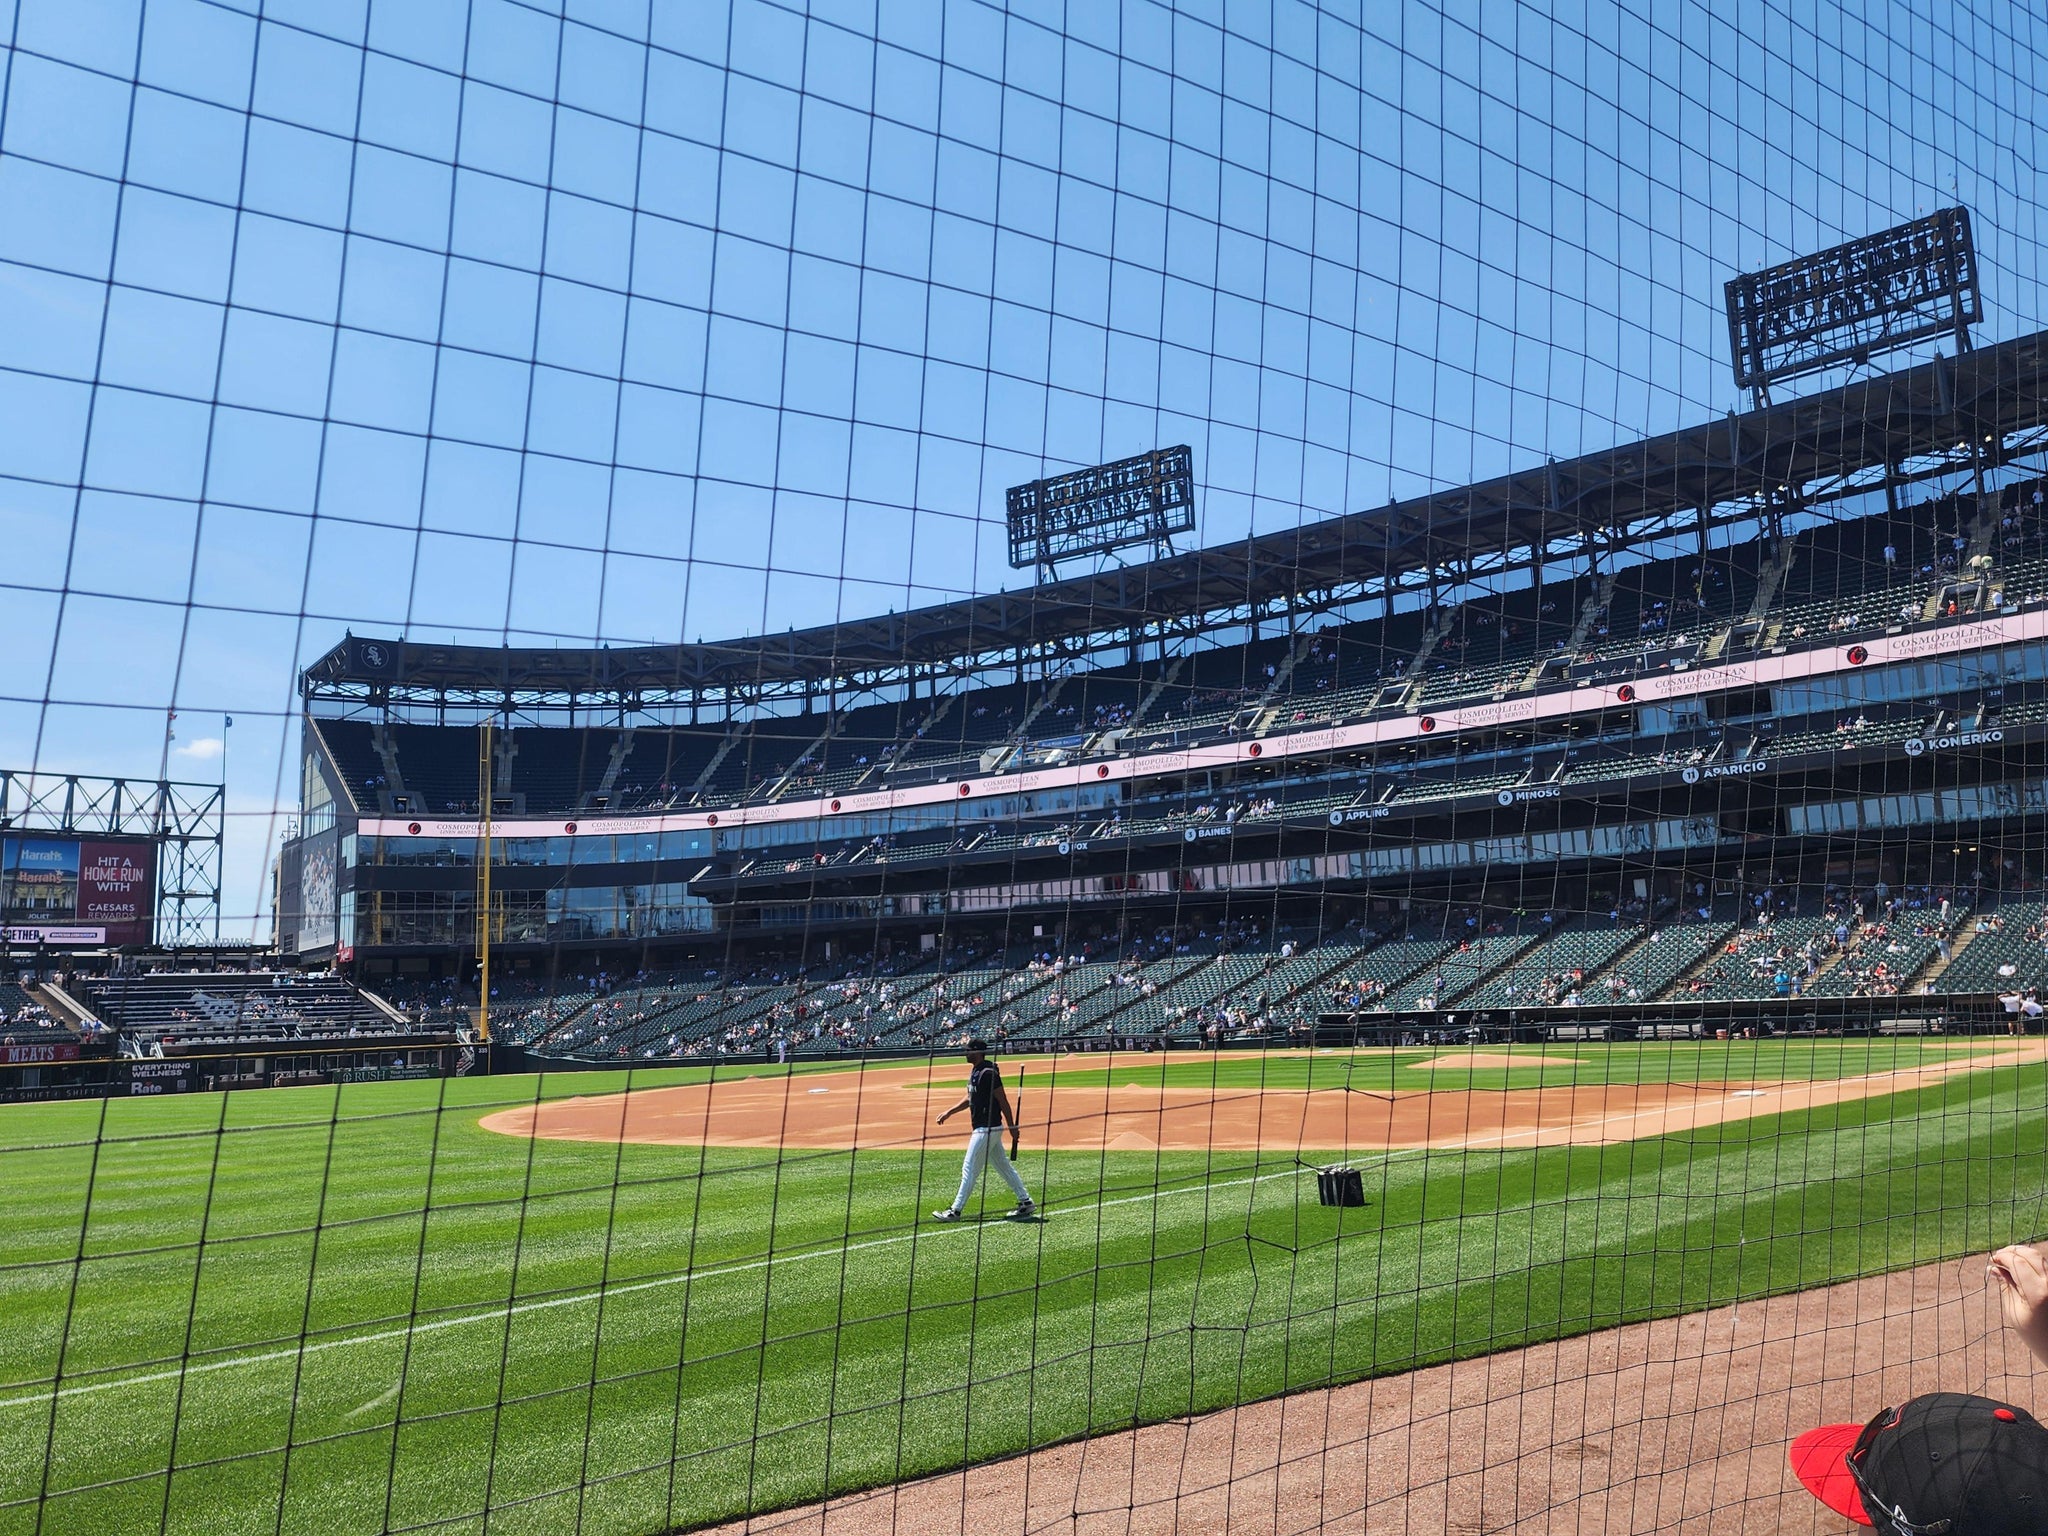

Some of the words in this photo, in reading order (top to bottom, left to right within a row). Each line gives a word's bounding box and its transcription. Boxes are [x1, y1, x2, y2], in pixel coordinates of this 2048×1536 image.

[1892, 623, 2002, 649] COSMOPOLITAN
[1899, 645, 1926, 655] LINEN
[1927, 639, 1960, 650] RENTAL
[1963, 633, 2000, 645] SERVICE
[1655, 667, 1747, 689] COSMOPOLITAN
[1453, 702, 1533, 720] COSMOPOLITAN
[1277, 730, 1347, 747] COSMOPOLITAN
[1928, 731, 2003, 750] KONERKO
[1123, 756, 1184, 769] COSMOPOLITAN
[1703, 761, 1767, 779] APARICIO
[983, 775, 1040, 788] COSMOPOLITAN
[1515, 789, 1560, 801] MINOSO
[1345, 808, 1390, 821] APPLING
[591, 819, 652, 828] COSMOPOLITAN
[1198, 827, 1232, 838] BAINES
[98, 857, 119, 867] HIT
[122, 857, 132, 867] A
[84, 867, 118, 881] HOME
[120, 867, 144, 882] RUN
[97, 881, 130, 892] WITH
[88, 903, 135, 912] CAESARS
[88, 912, 135, 920] REWARDS
[195, 937, 253, 948] LANDING
[8, 1046, 55, 1062] MEATS
[132, 1062, 191, 1072] EVERYTHING
[132, 1069, 183, 1078] WELLNESS
[354, 1070, 386, 1082] RUSH
[66, 1088, 94, 1097] SHIFT
[131, 1081, 162, 1095] Rate
[20, 1091, 50, 1100] SHIFT
